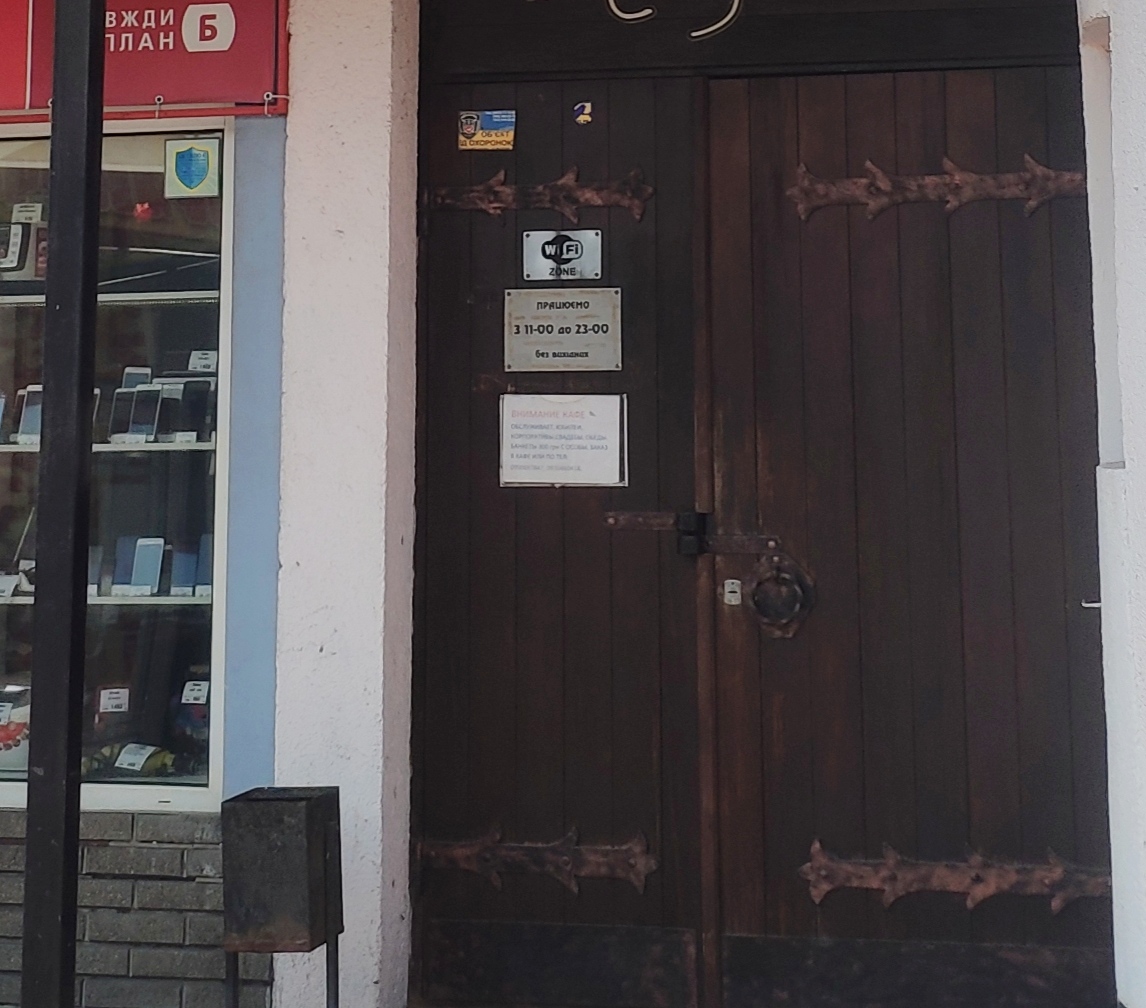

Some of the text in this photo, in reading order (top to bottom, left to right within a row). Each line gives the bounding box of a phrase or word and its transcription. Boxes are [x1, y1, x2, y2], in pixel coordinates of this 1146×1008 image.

[105, 9, 174, 30] ВЖДИ
[199, 14, 218, 42] Б
[549, 267, 577, 277] ZONE
[536, 301, 590, 311] ПРАЦЮЄМО
[525, 324, 554, 335] 11-00
[558, 326, 572, 335] до
[575, 323, 609, 335] 23-00
[535, 349, 549, 359] без
